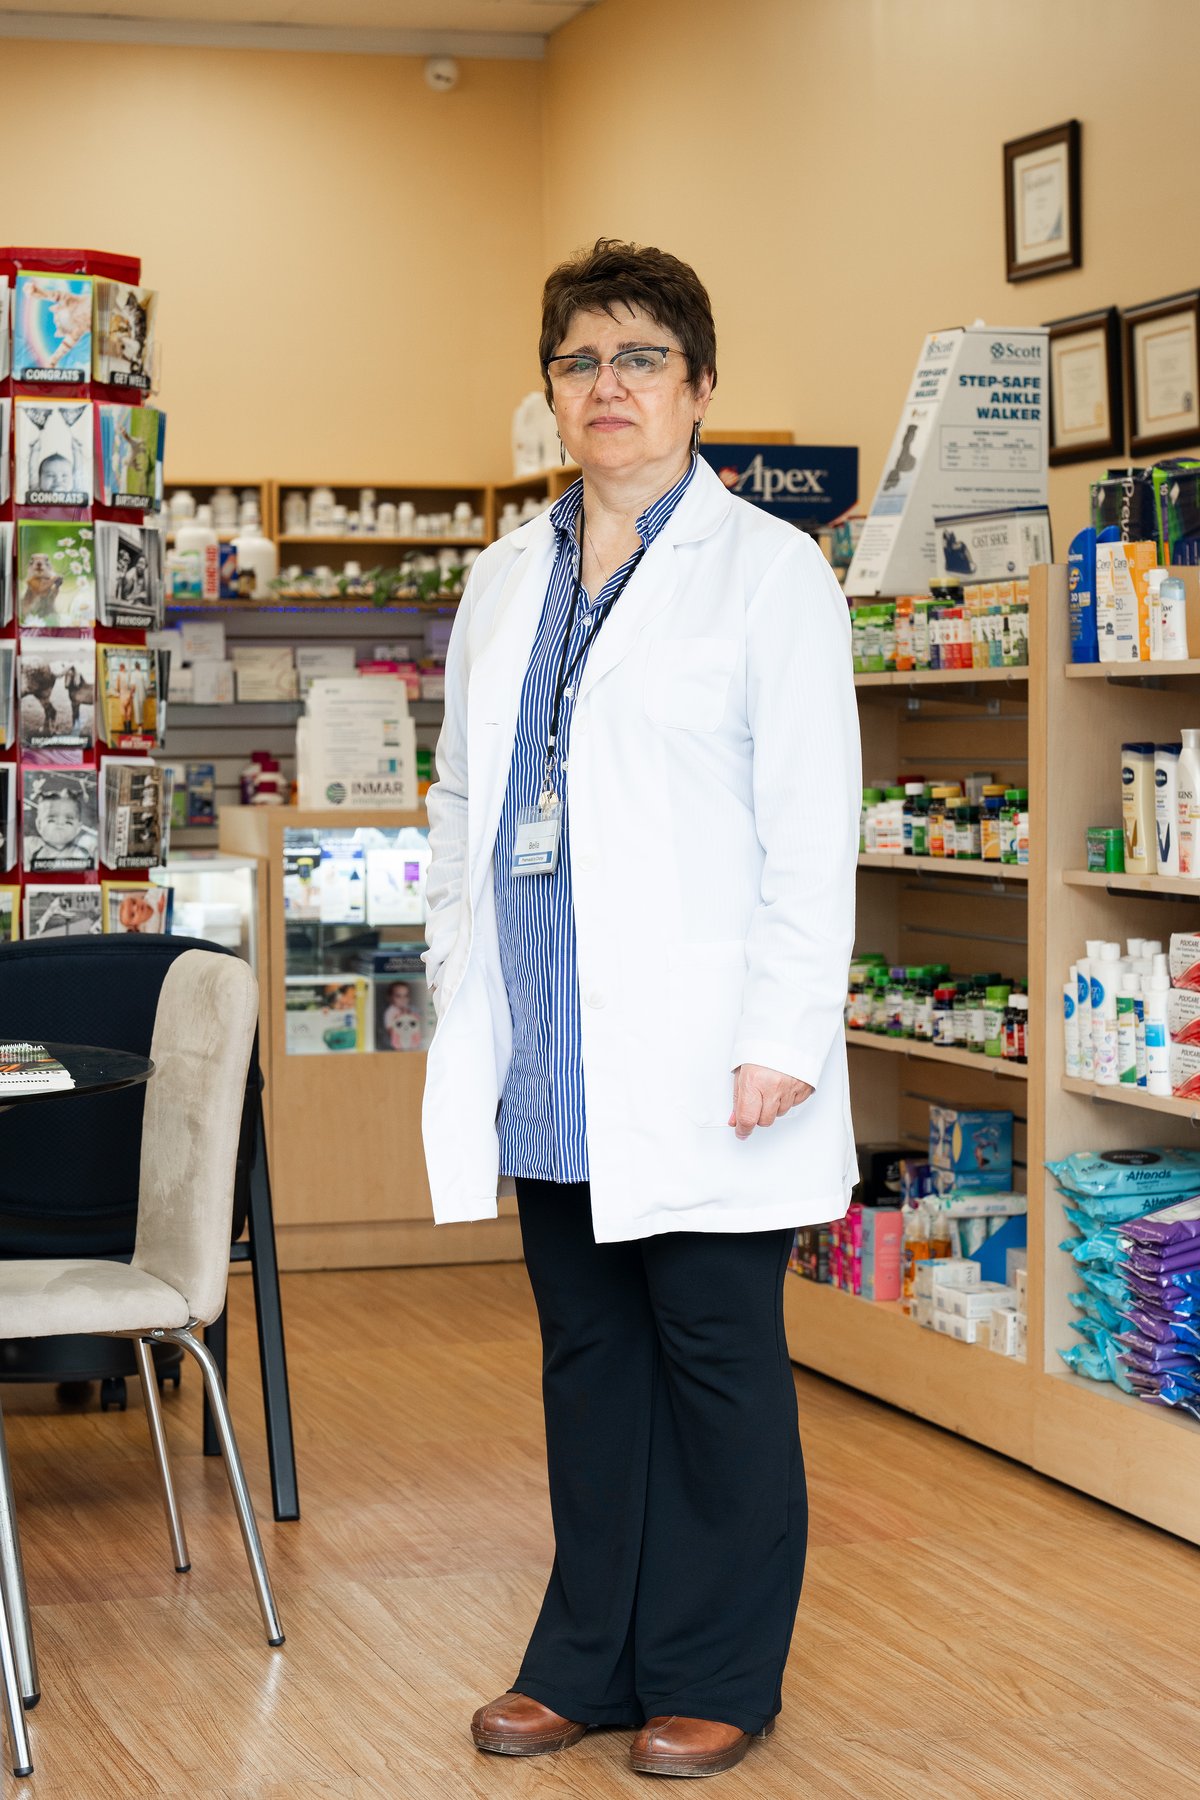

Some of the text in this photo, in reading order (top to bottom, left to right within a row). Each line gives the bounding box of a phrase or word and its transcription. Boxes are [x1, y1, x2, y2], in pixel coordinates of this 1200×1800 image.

[1006, 343, 1041, 358] Scott
[26, 369, 80, 381] CONGRATS
[114, 373, 148, 388] GET WELL
[959, 375, 1041, 389] STEP-SAFE
[990, 392, 1041, 405] ANKLE
[976, 407, 1041, 421] WALKER
[734, 453, 824, 502] Apex
[30, 491, 84, 504] CONGRATS
[351, 781, 404, 795] INMAR
[1126, 1169, 1172, 1182] Attends
